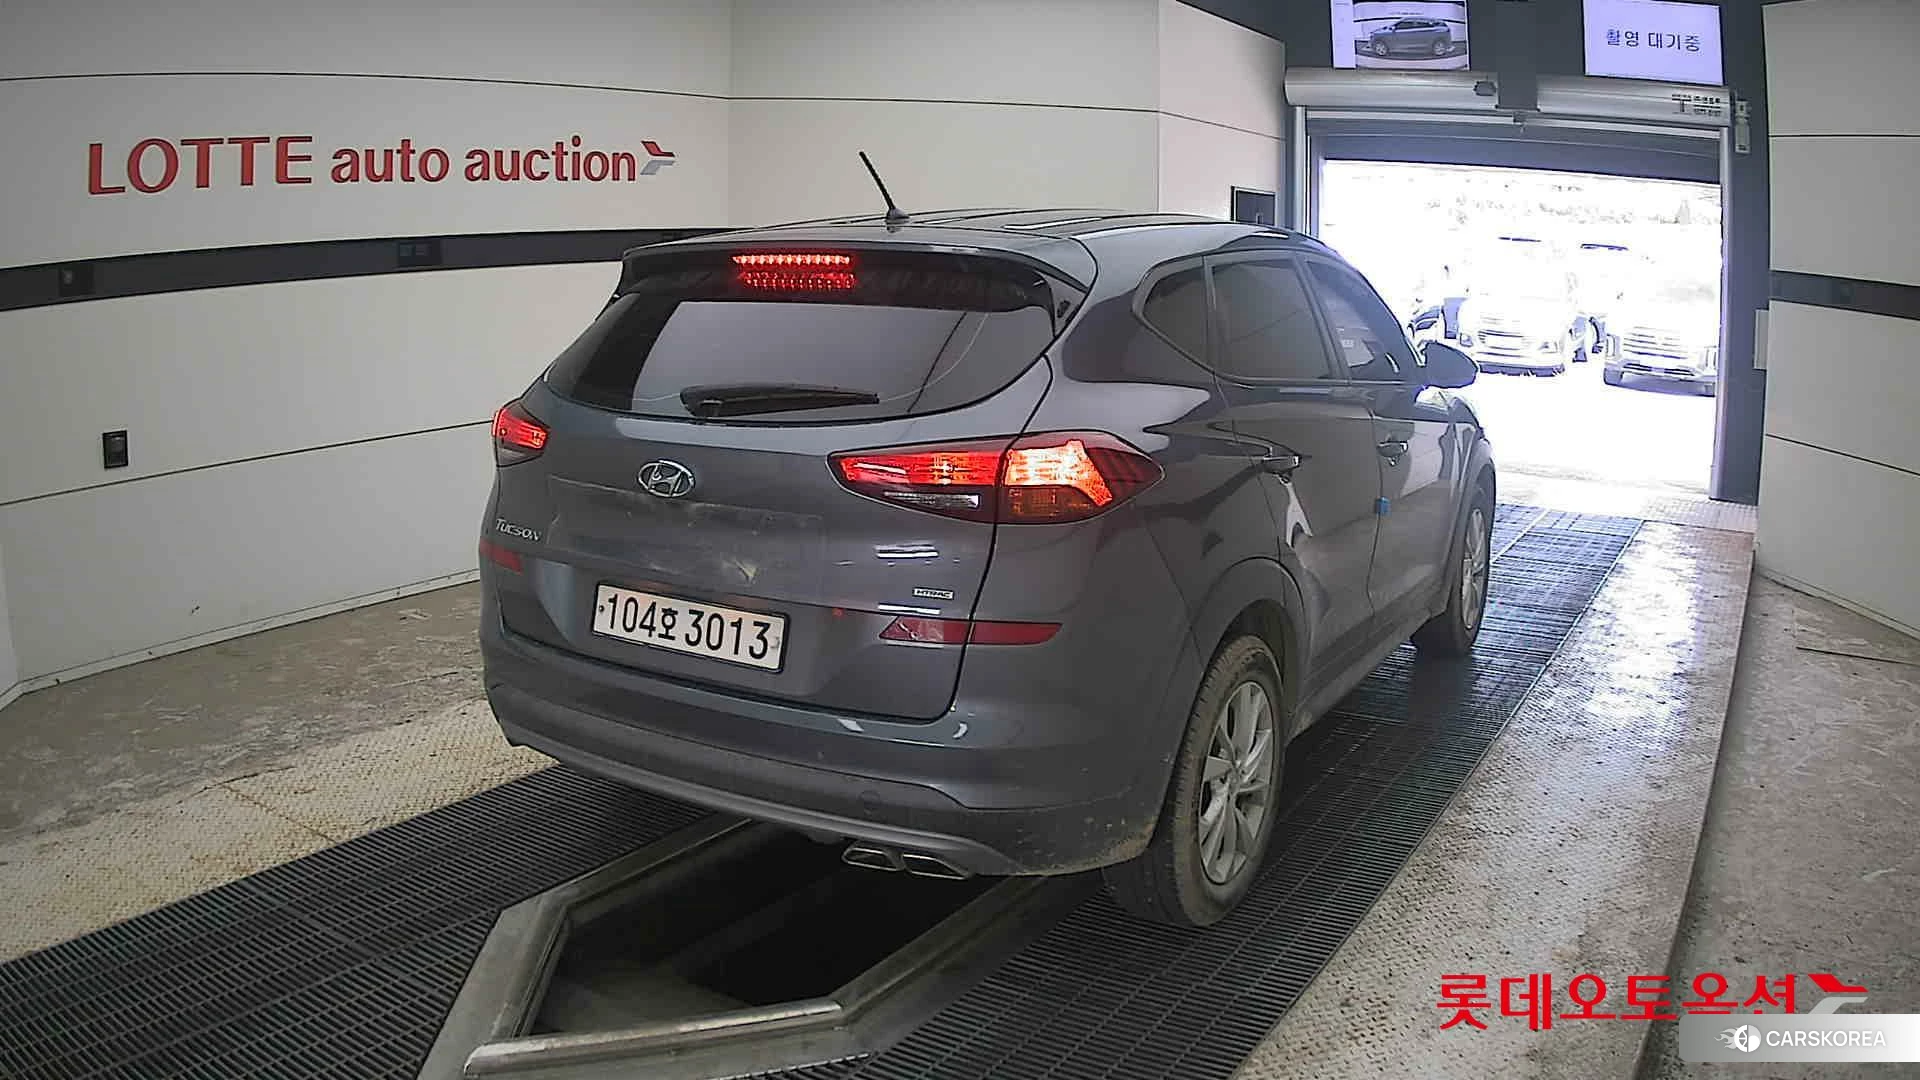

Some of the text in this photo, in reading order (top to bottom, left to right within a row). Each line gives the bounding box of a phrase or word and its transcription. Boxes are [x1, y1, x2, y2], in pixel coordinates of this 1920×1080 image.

[1647, 32, 1700, 52] 대기중
[88, 135, 637, 195] LOTTE auto auction
[684, 609, 771, 660] 3013
